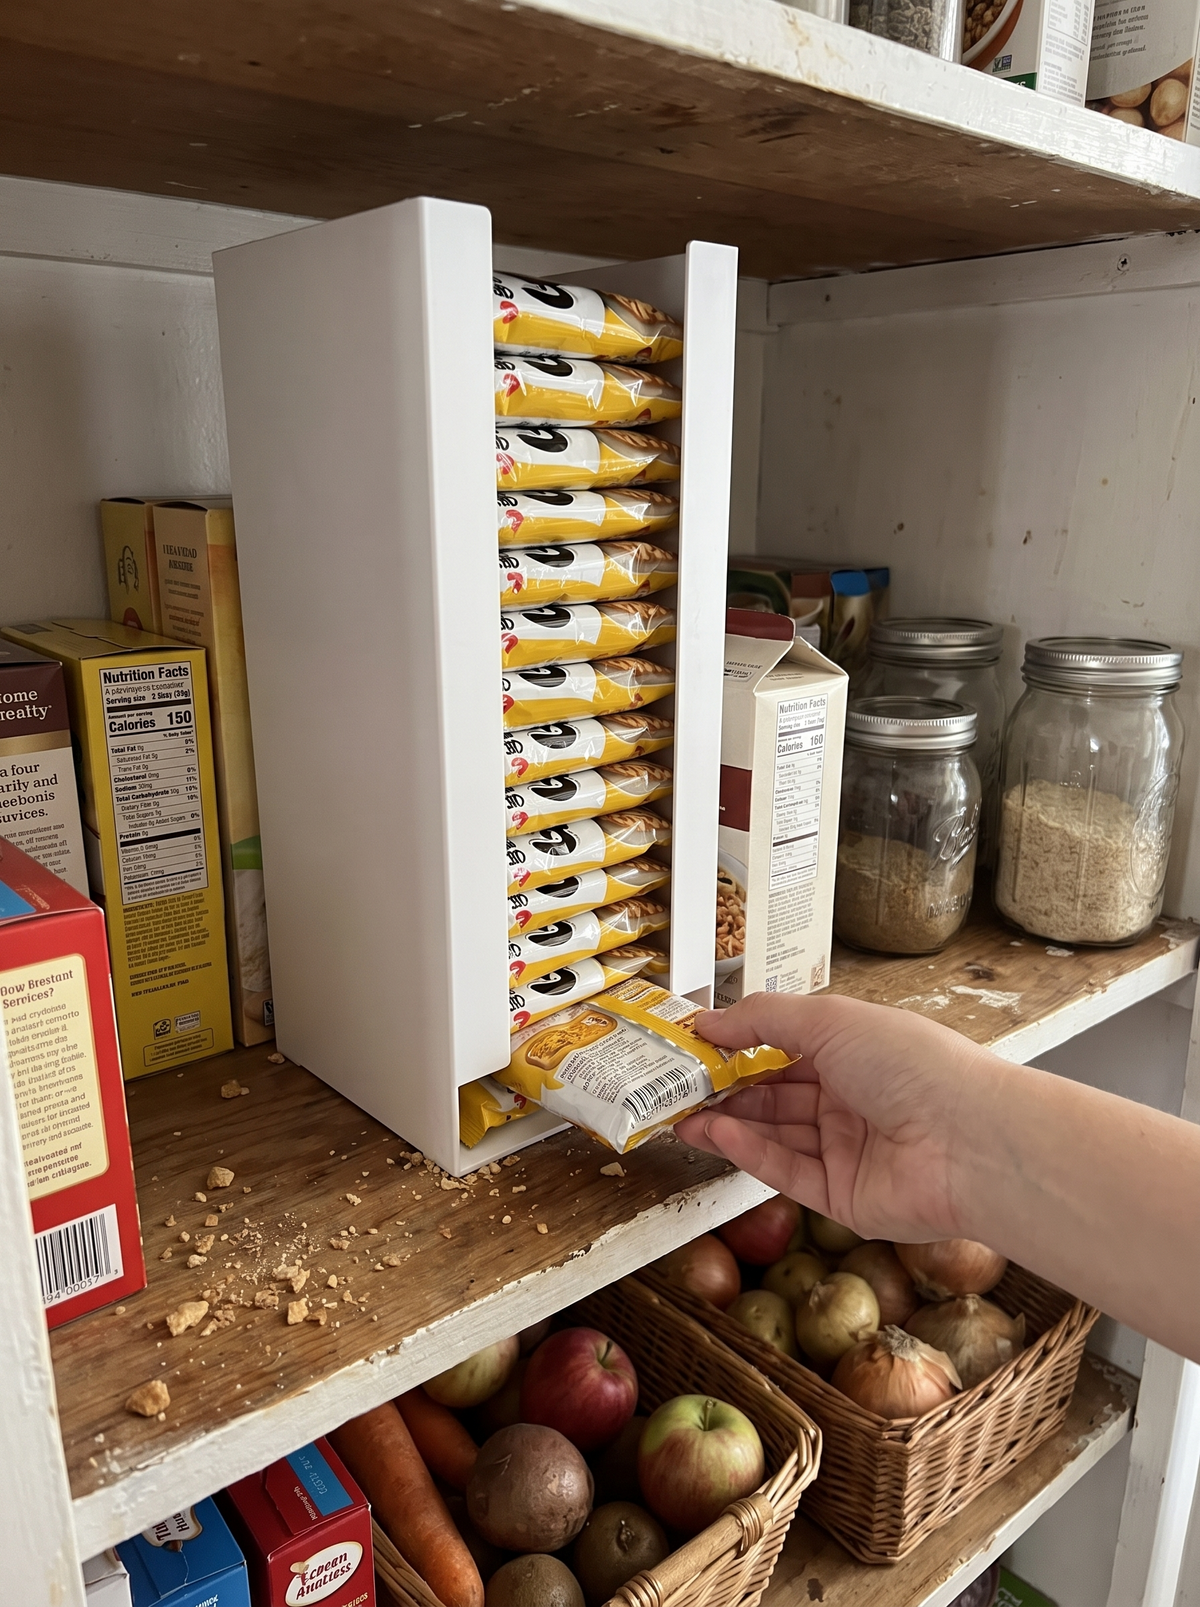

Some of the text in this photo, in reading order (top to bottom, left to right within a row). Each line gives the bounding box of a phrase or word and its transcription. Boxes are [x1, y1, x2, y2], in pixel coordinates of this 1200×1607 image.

[103, 666, 189, 684] Nutrition Facts
[0, 690, 38, 704] ome
[106, 696, 131, 705] Serving
[779, 698, 825, 714] Nutrition Facts
[109, 710, 191, 733] Calories 150
[778, 734, 823, 753] Calories 160
[11, 764, 39, 776] four
[33, 774, 58, 788] and
[28, 970, 74, 990] Brestant
[3, 988, 54, 1009] Services?
